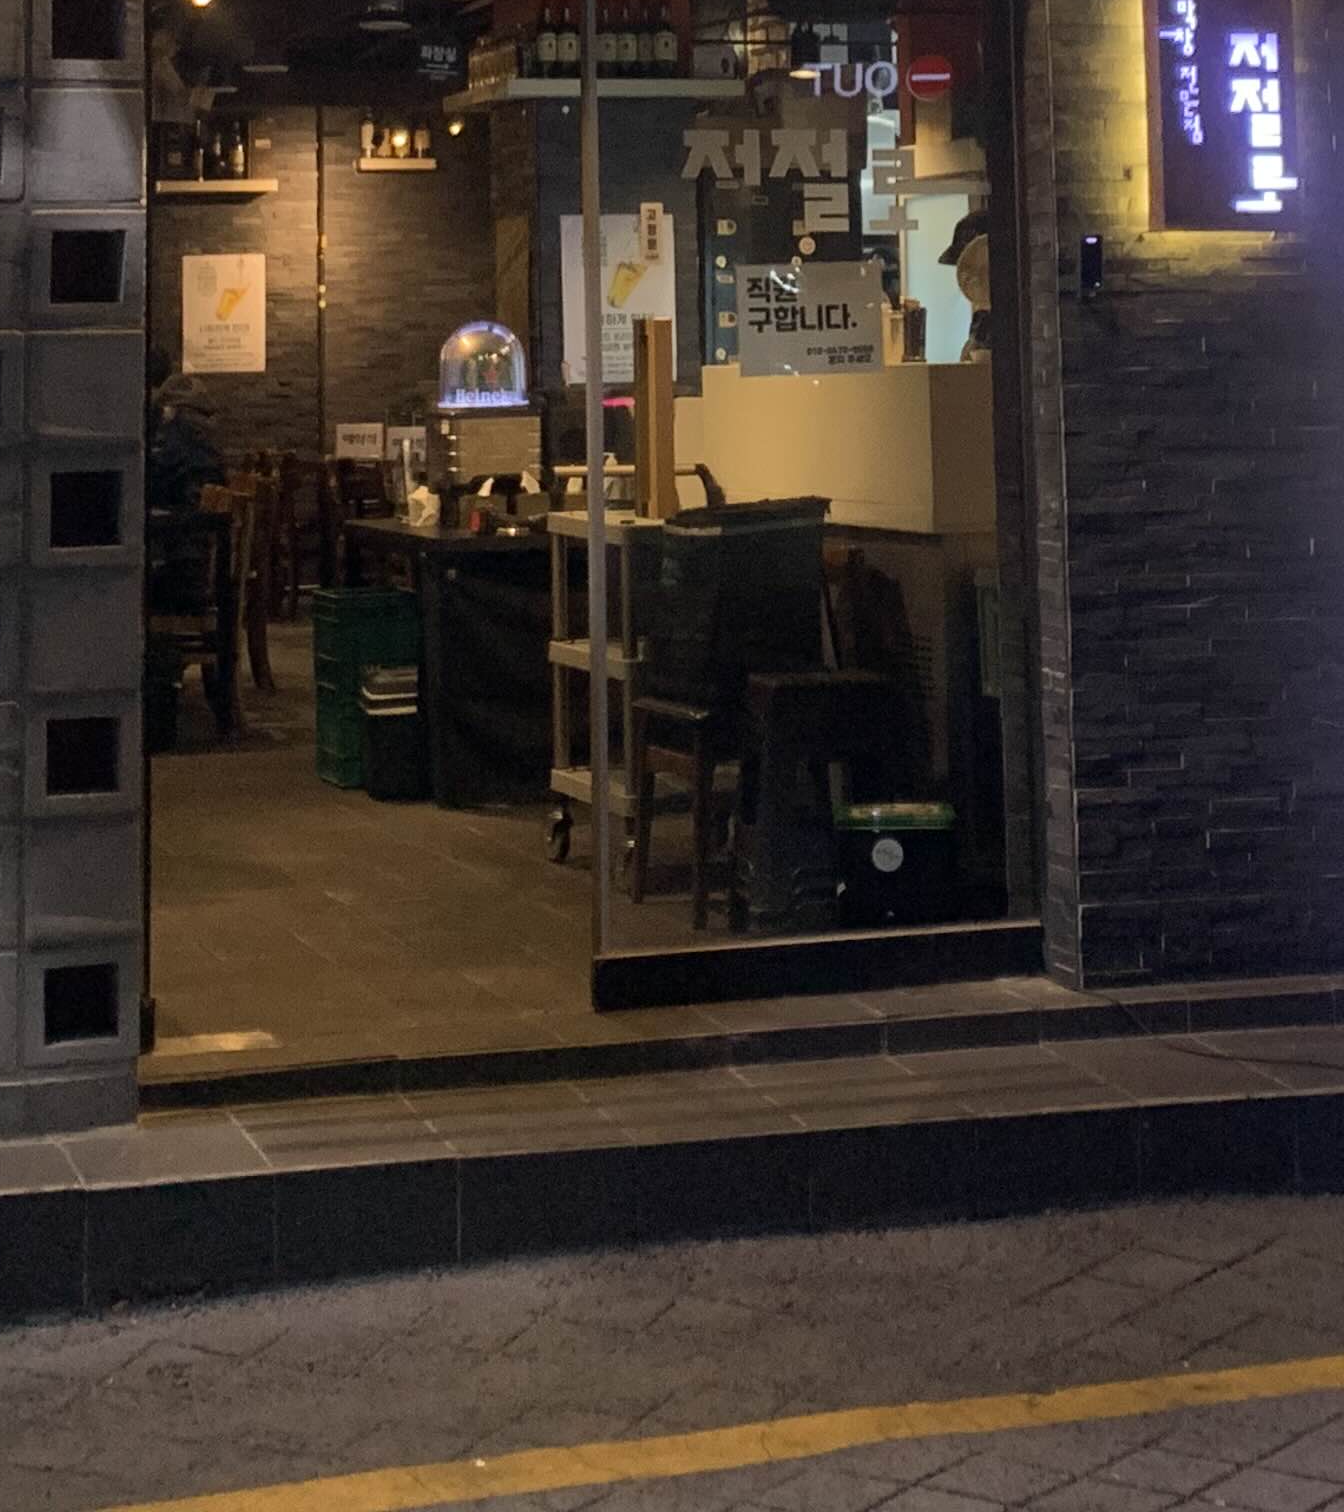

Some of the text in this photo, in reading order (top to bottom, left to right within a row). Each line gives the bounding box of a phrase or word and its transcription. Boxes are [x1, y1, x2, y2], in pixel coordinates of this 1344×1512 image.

[1228, 32, 1299, 213] 저절로
[681, 128, 991, 234] 저절로
[748, 303, 858, 333] 구합니다.
[455, 389, 518, 403] Heinek
